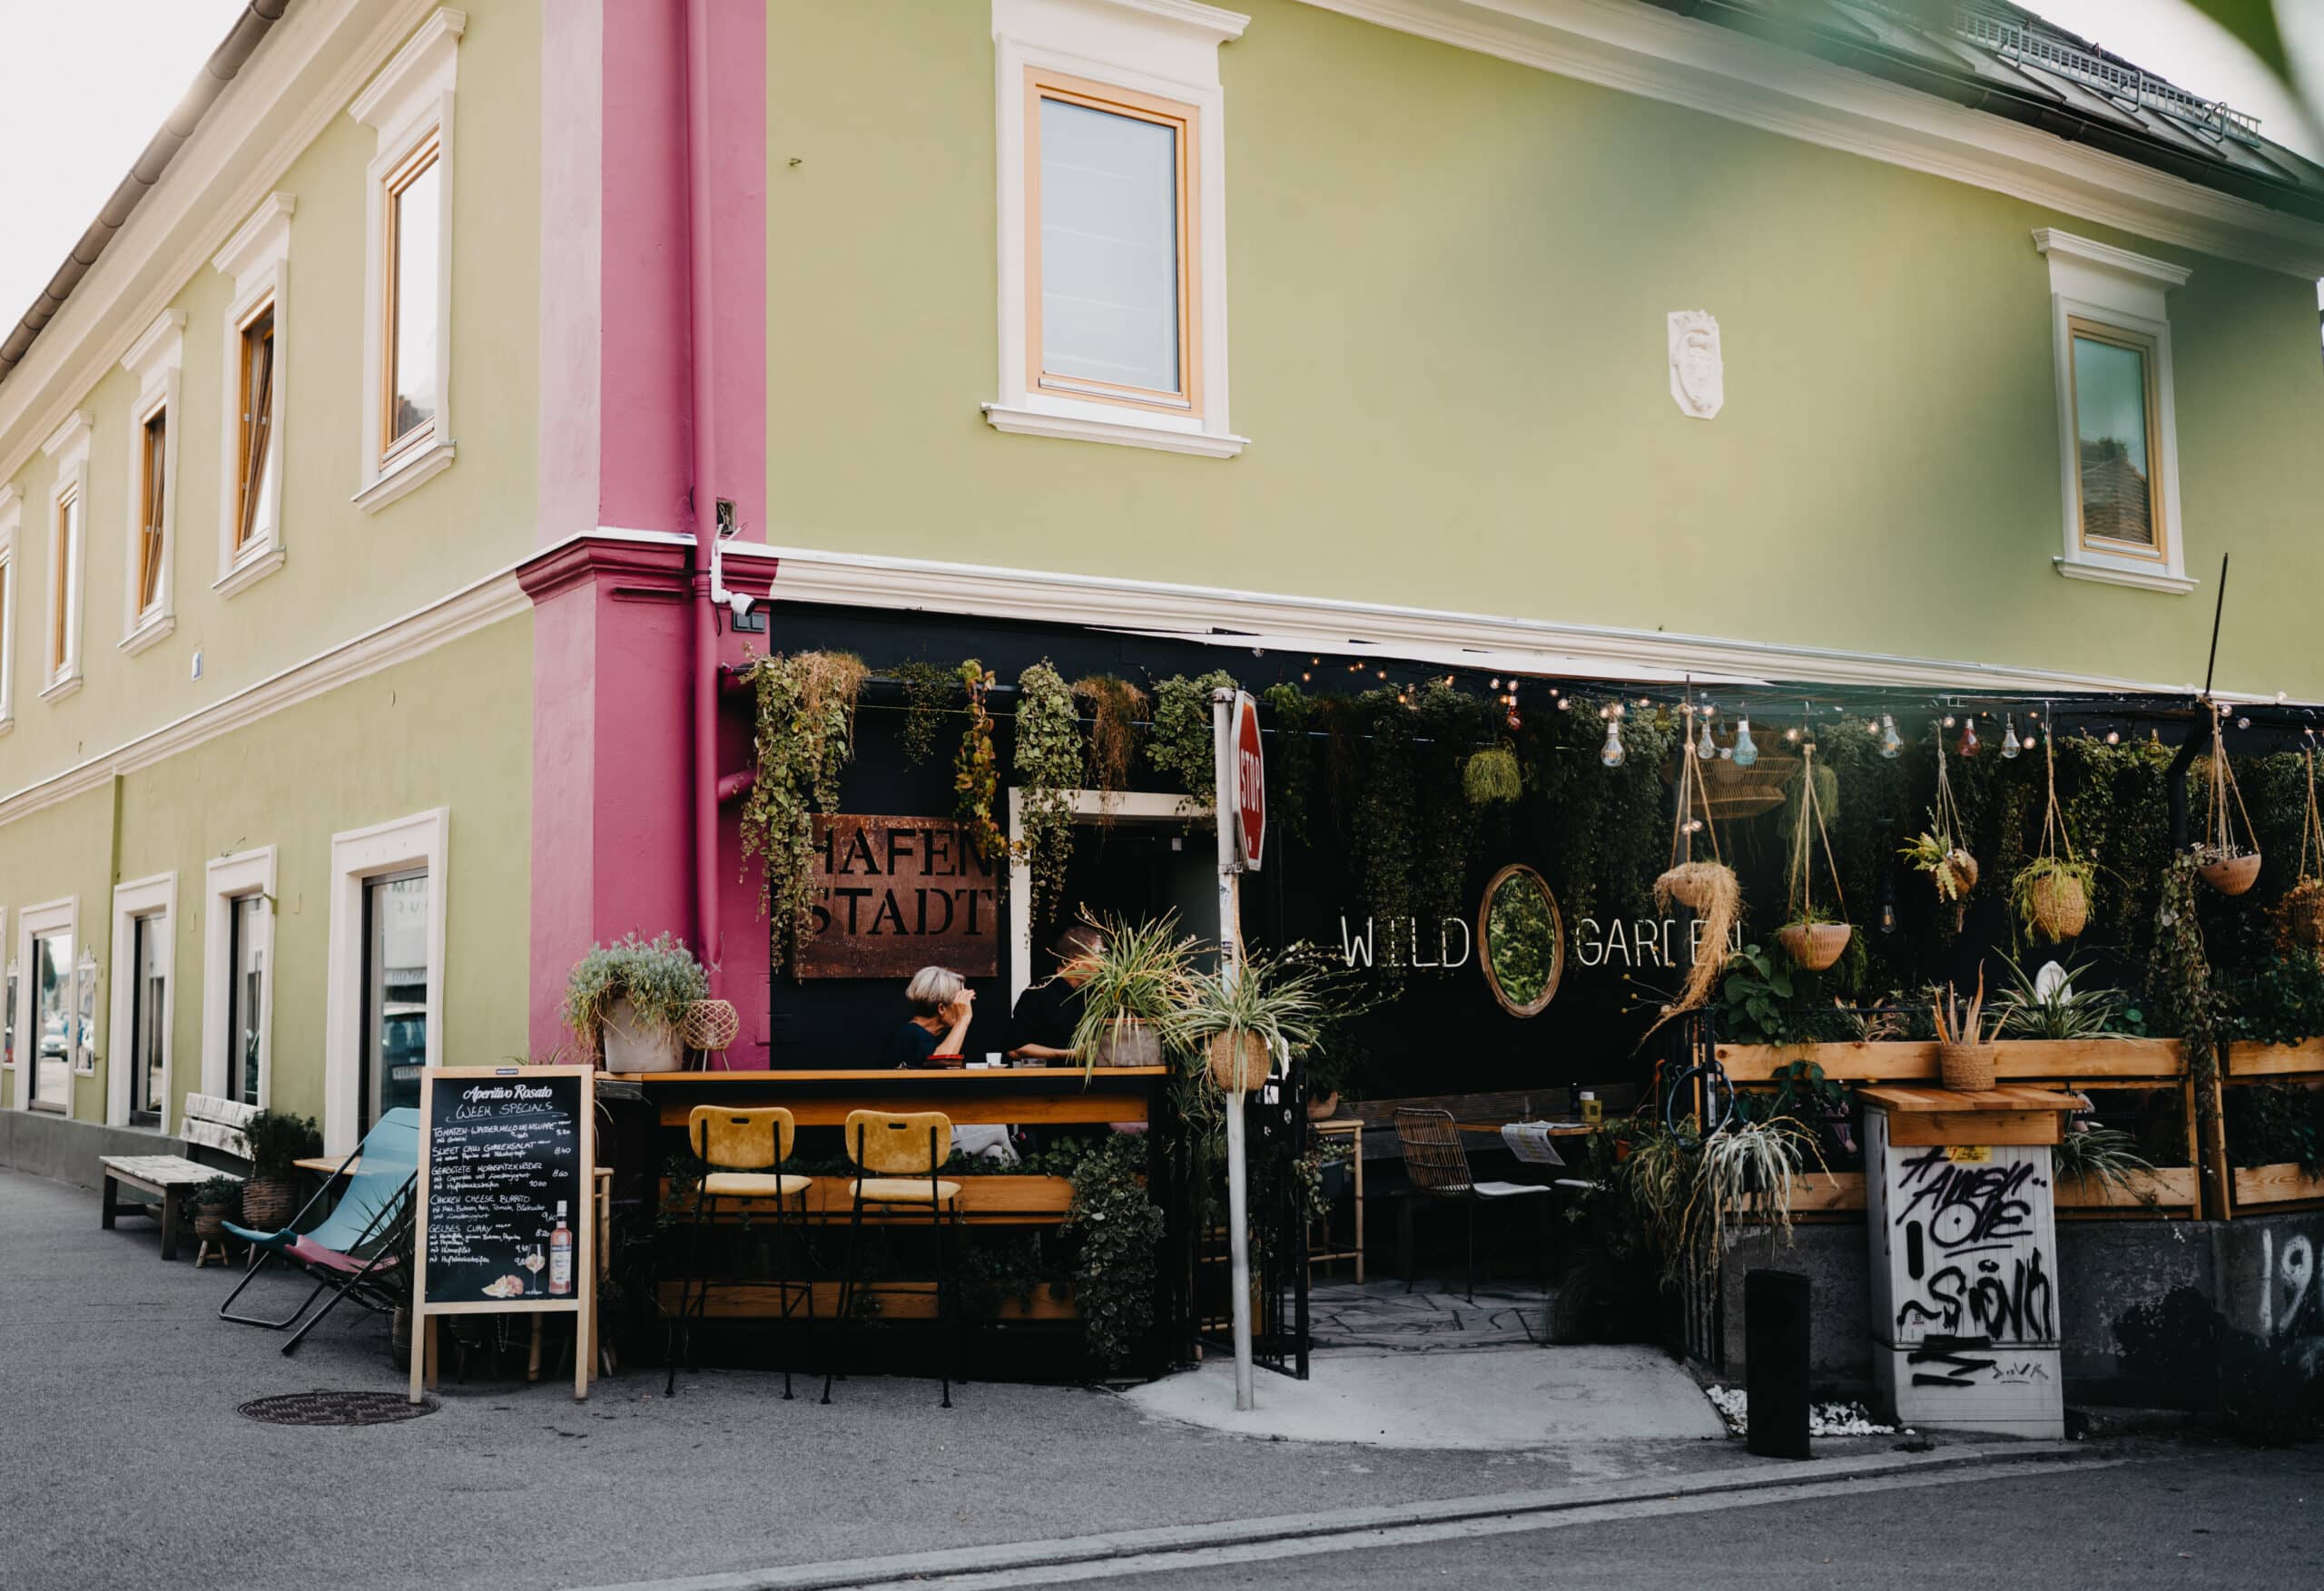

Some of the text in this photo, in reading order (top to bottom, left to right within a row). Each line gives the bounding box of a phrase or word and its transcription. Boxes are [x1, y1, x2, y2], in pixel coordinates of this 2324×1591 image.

[1241, 748, 1260, 814] STOP
[1341, 915, 1470, 967] WILD
[463, 1085, 552, 1103] Aperitivo Rosato
[456, 1101, 553, 1120] WEEK SPECIALS
[432, 1146, 460, 1157] SWEET
[430, 1194, 531, 1205] CHICKEN CHEESE BURRITO
[428, 1224, 461, 1234] GELBES
[467, 1224, 494, 1236] CURRY
